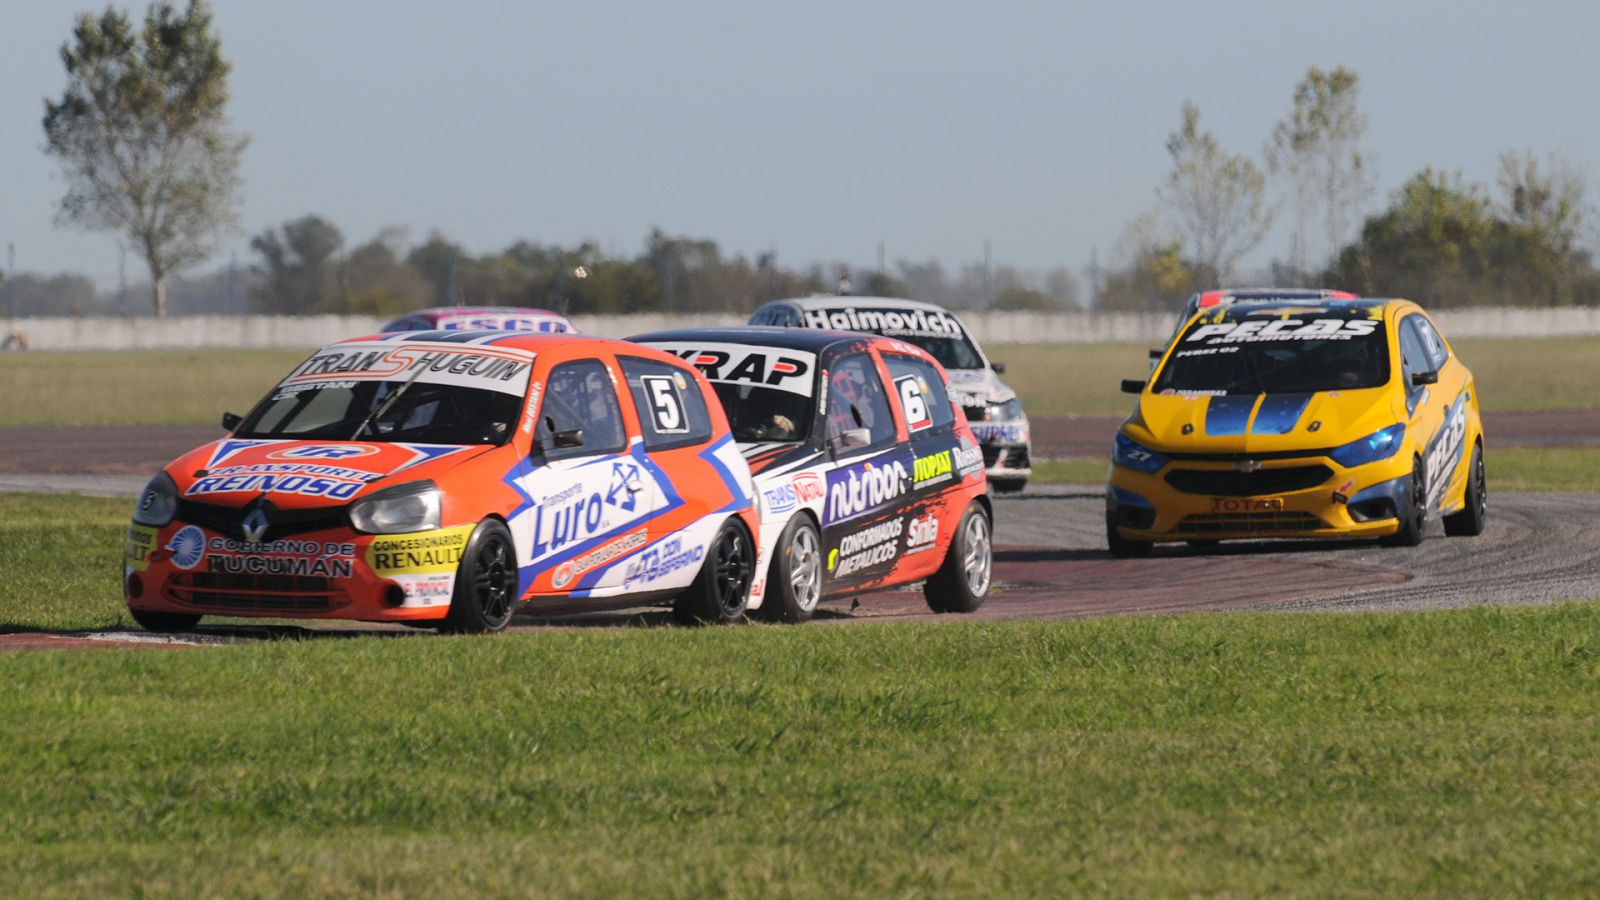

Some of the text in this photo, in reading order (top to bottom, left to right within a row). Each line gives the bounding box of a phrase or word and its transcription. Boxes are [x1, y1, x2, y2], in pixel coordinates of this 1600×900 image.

[805, 308, 960, 335] Haimovich
[1186, 319, 1379, 342] PECAS
[663, 350, 808, 386] RAP
[650, 380, 680, 429] 5
[899, 377, 926, 425] 6
[207, 463, 385, 482] TRANSPORTE
[185, 475, 366, 499] REINOSO
[763, 483, 796, 507] TRANS
[829, 461, 907, 522] nutribon
[531, 492, 602, 560] Luro
[839, 516, 904, 557] CONFORMADOS
[208, 536, 357, 557] GOBIERNO DE
[374, 534, 463, 551] CONCESIONARIOS
[206, 552, 354, 579] TUCUMÁN
[374, 547, 464, 570] RENAULT
[834, 539, 898, 579] METALICOS
